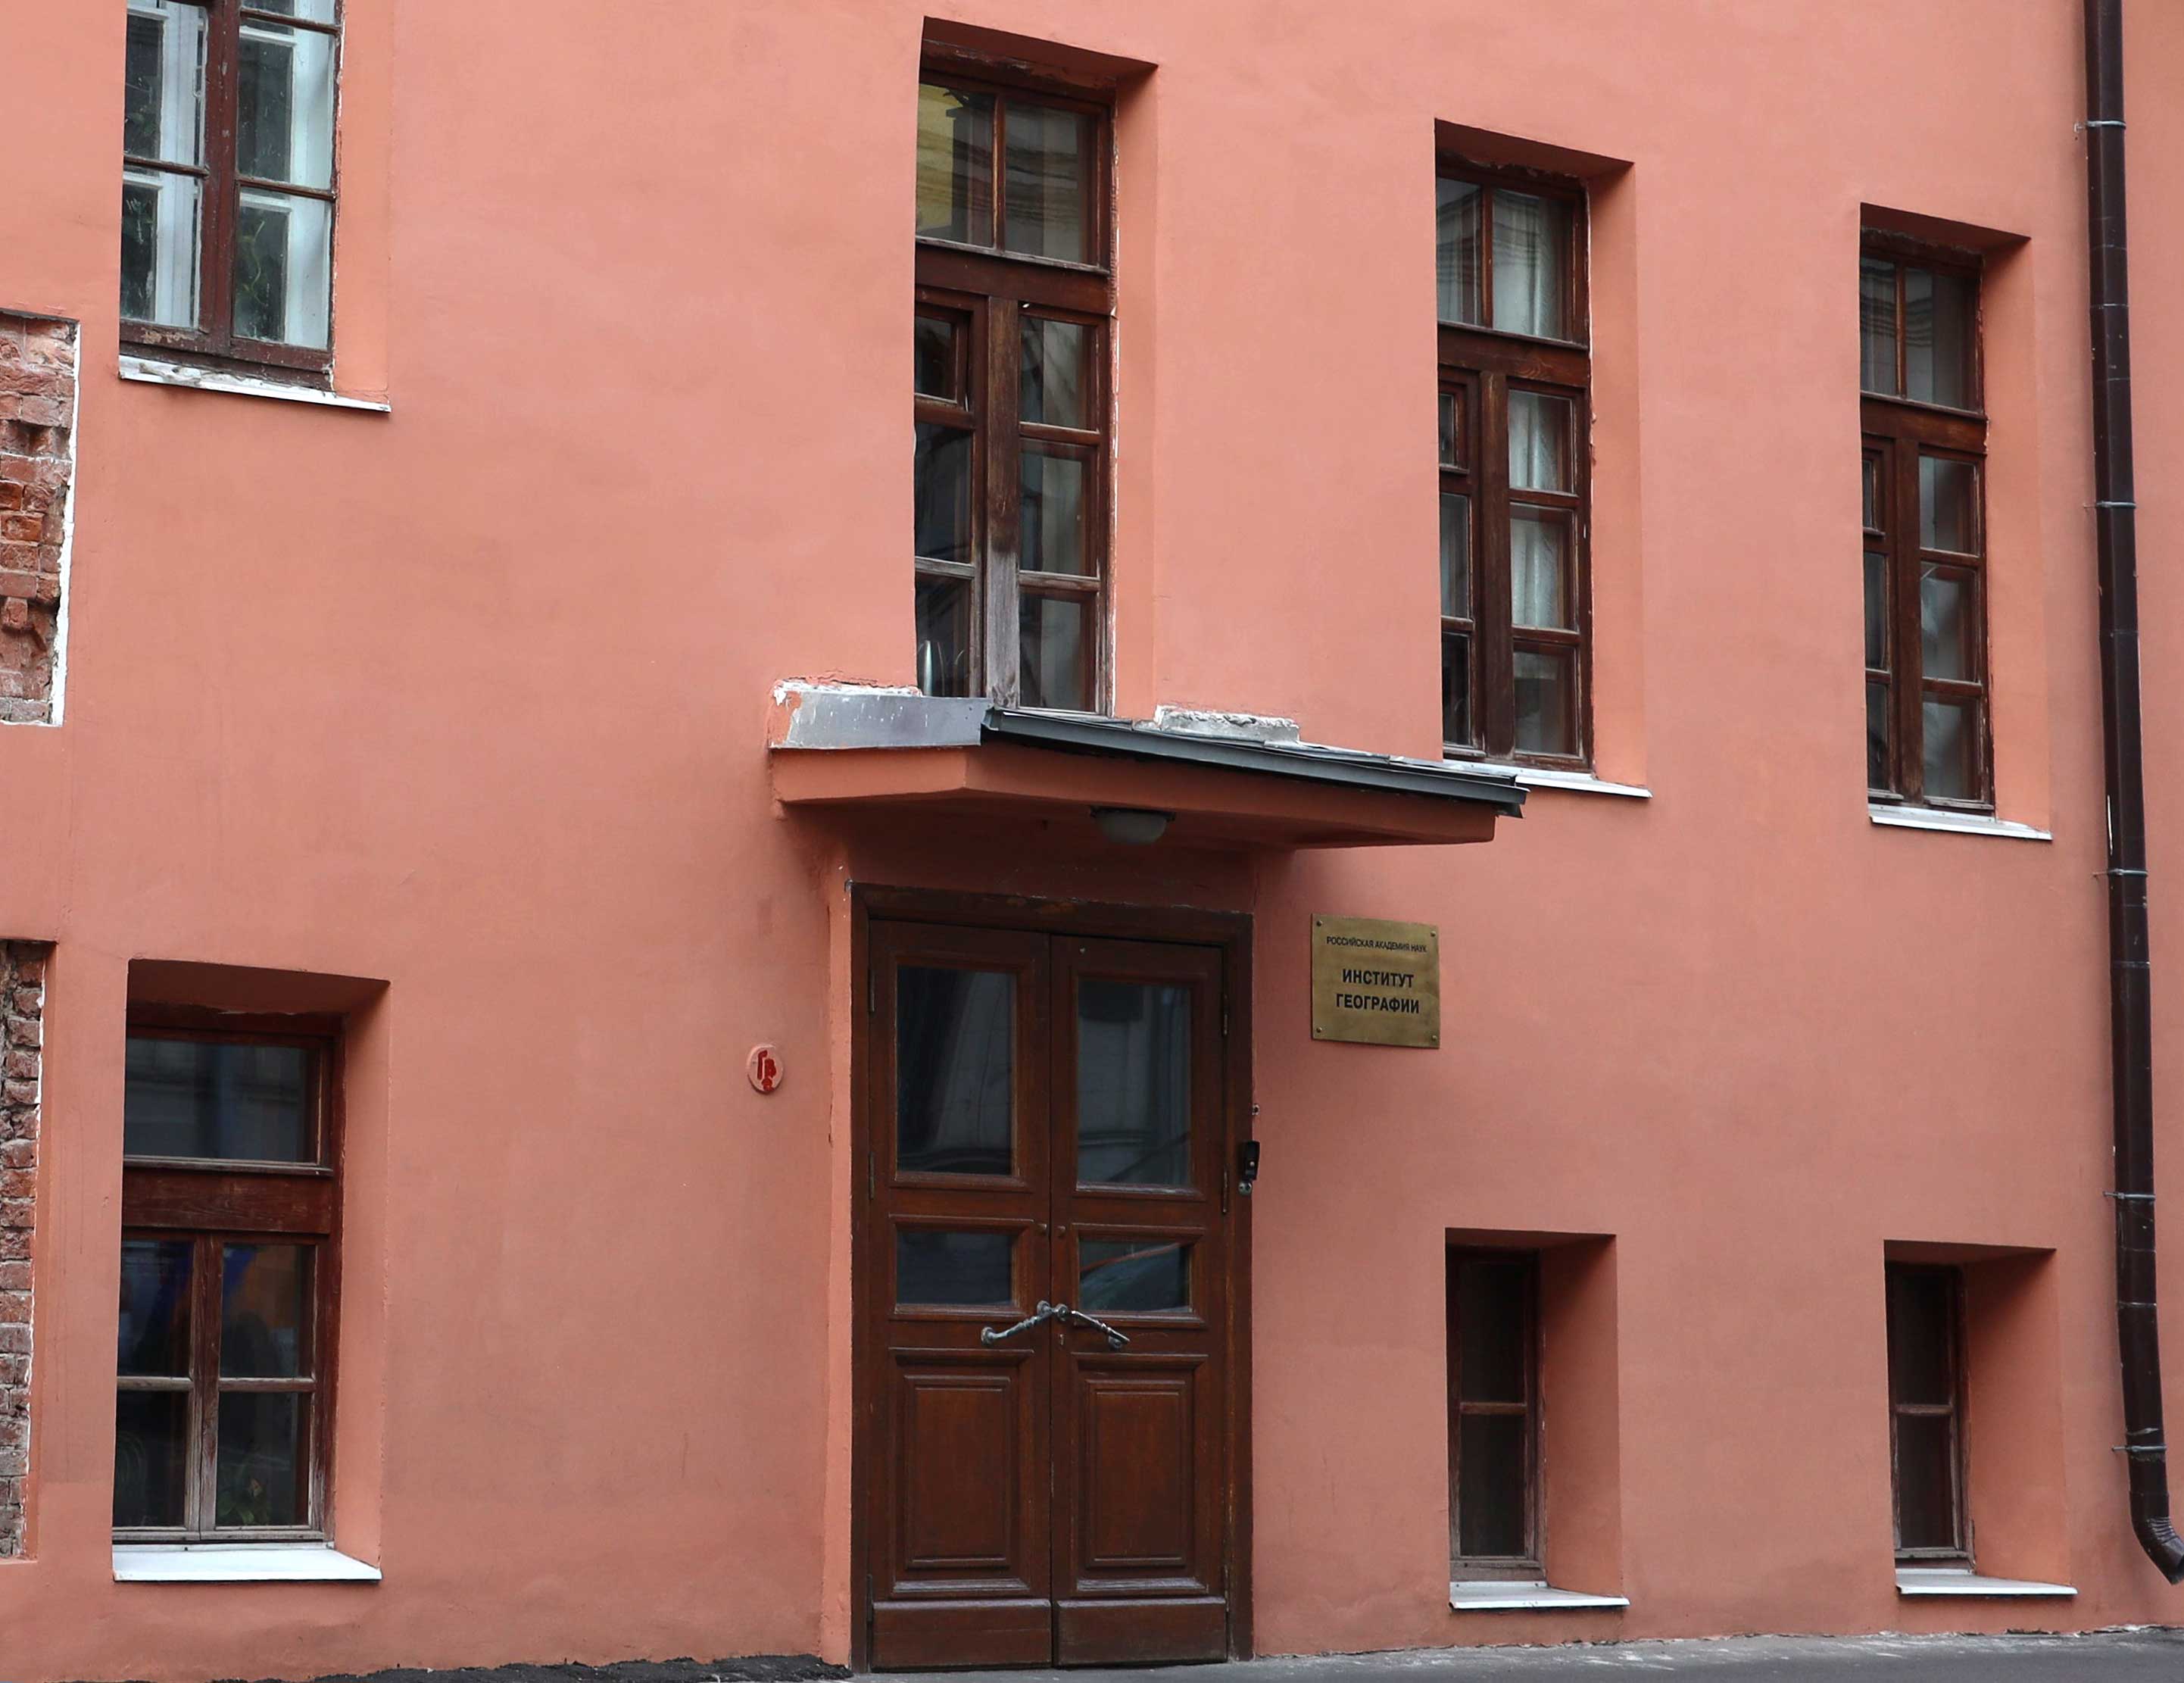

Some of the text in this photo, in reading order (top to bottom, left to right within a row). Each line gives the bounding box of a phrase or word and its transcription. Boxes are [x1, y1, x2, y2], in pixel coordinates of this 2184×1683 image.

[1327, 936, 1427, 952] РОССИЙСКАЯ АКАДЕМИЯ НАУК
[1343, 969, 1414, 988] ИНСТИТУТ
[1336, 993, 1419, 1013] ГЕОГРАФИИ
